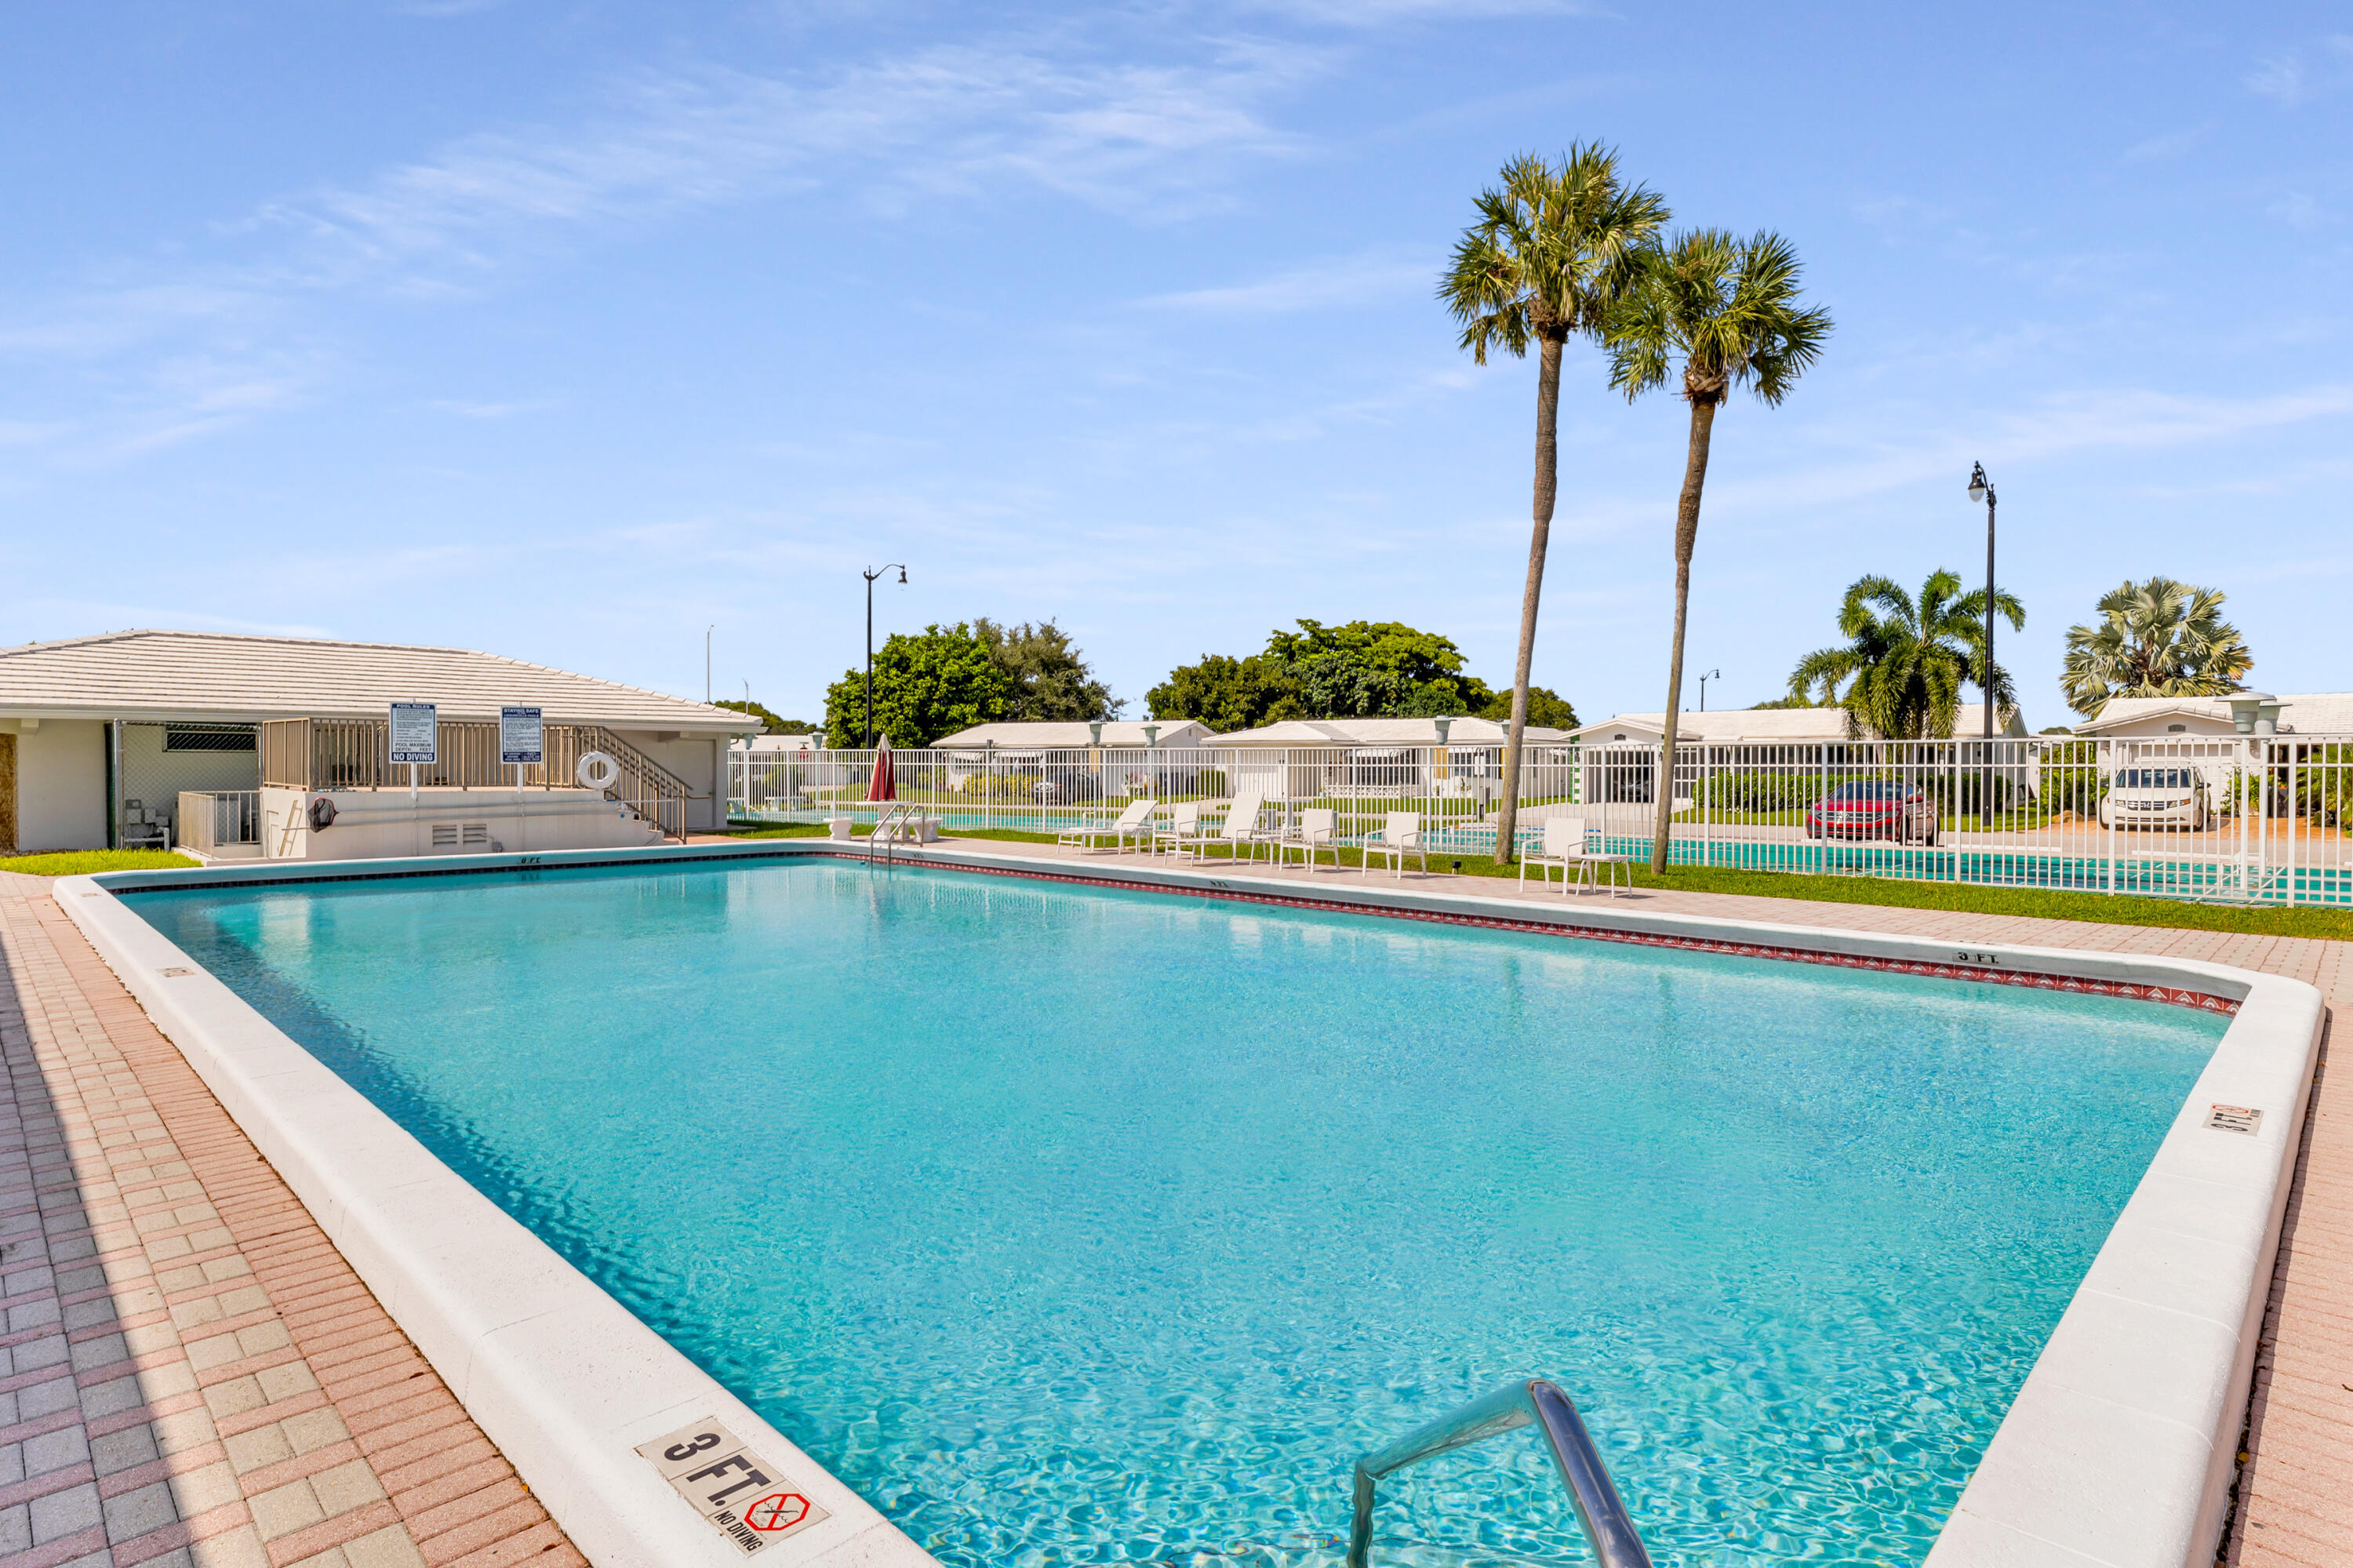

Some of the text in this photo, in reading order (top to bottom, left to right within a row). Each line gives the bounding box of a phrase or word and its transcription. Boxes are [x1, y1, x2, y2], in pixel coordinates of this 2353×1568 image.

[1958, 951, 1999, 964] 3 FT.
[664, 1433, 772, 1507] 3 FT.
[714, 1510, 764, 1552] NO DIVING
